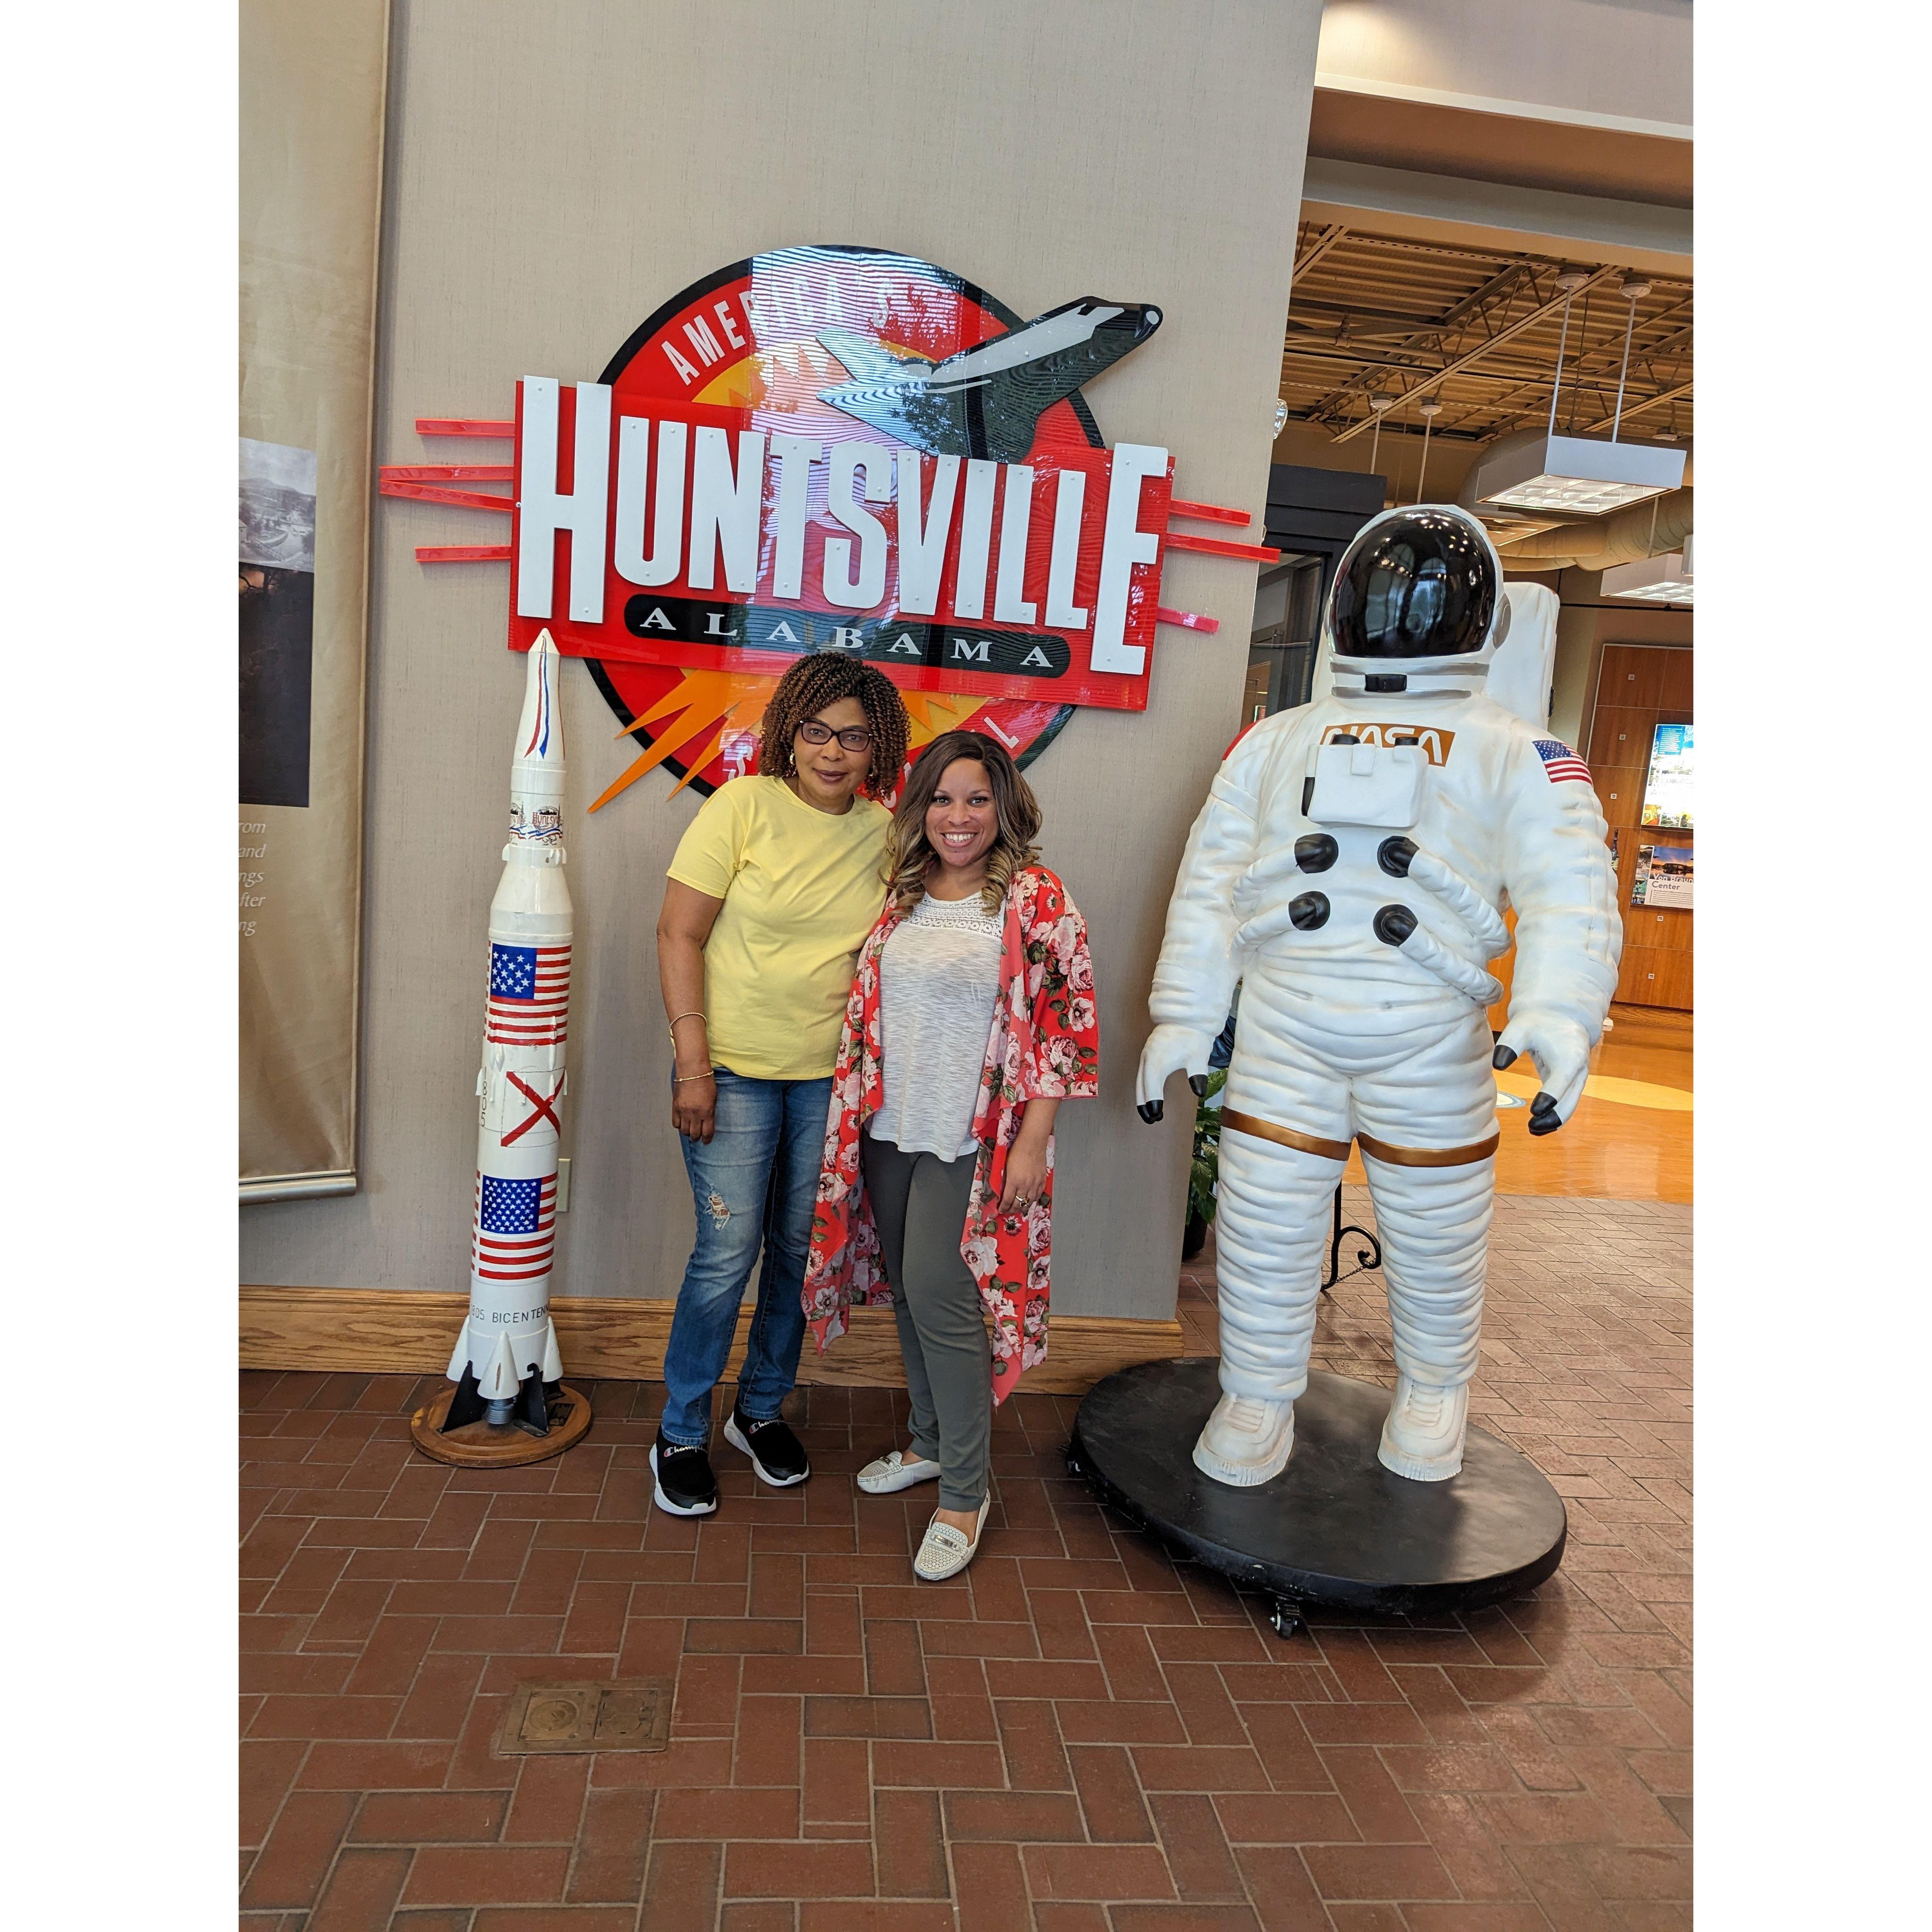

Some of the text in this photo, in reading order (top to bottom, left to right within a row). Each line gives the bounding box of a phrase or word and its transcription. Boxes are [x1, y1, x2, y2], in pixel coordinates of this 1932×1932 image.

[517, 375, 1169, 676] HUNTSVILLE
[640, 607, 1054, 668] ALABAMA
[239, 823, 266, 833] rom
[239, 872, 264, 887] ngs
[1653, 873, 1668, 881] Von
[1652, 881, 1681, 890] Center
[239, 892, 266, 907] fter
[239, 921, 257, 936] ng
